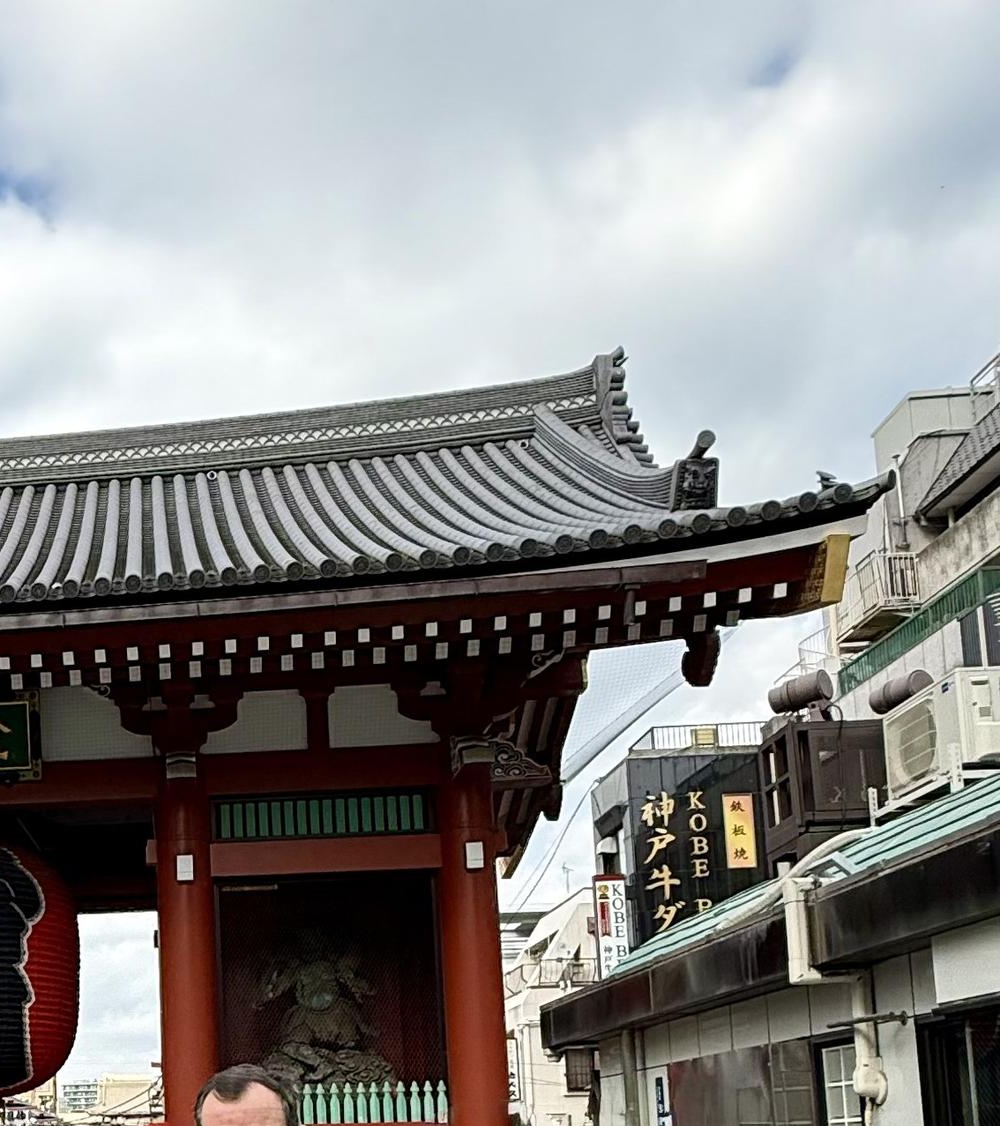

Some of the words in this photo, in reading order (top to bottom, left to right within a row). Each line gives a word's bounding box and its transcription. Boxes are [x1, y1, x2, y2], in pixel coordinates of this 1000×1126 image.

[686, 791, 710, 879] KOBE
[729, 800, 749, 861] 鉄板焼
[611, 883, 626, 938] KOBE
